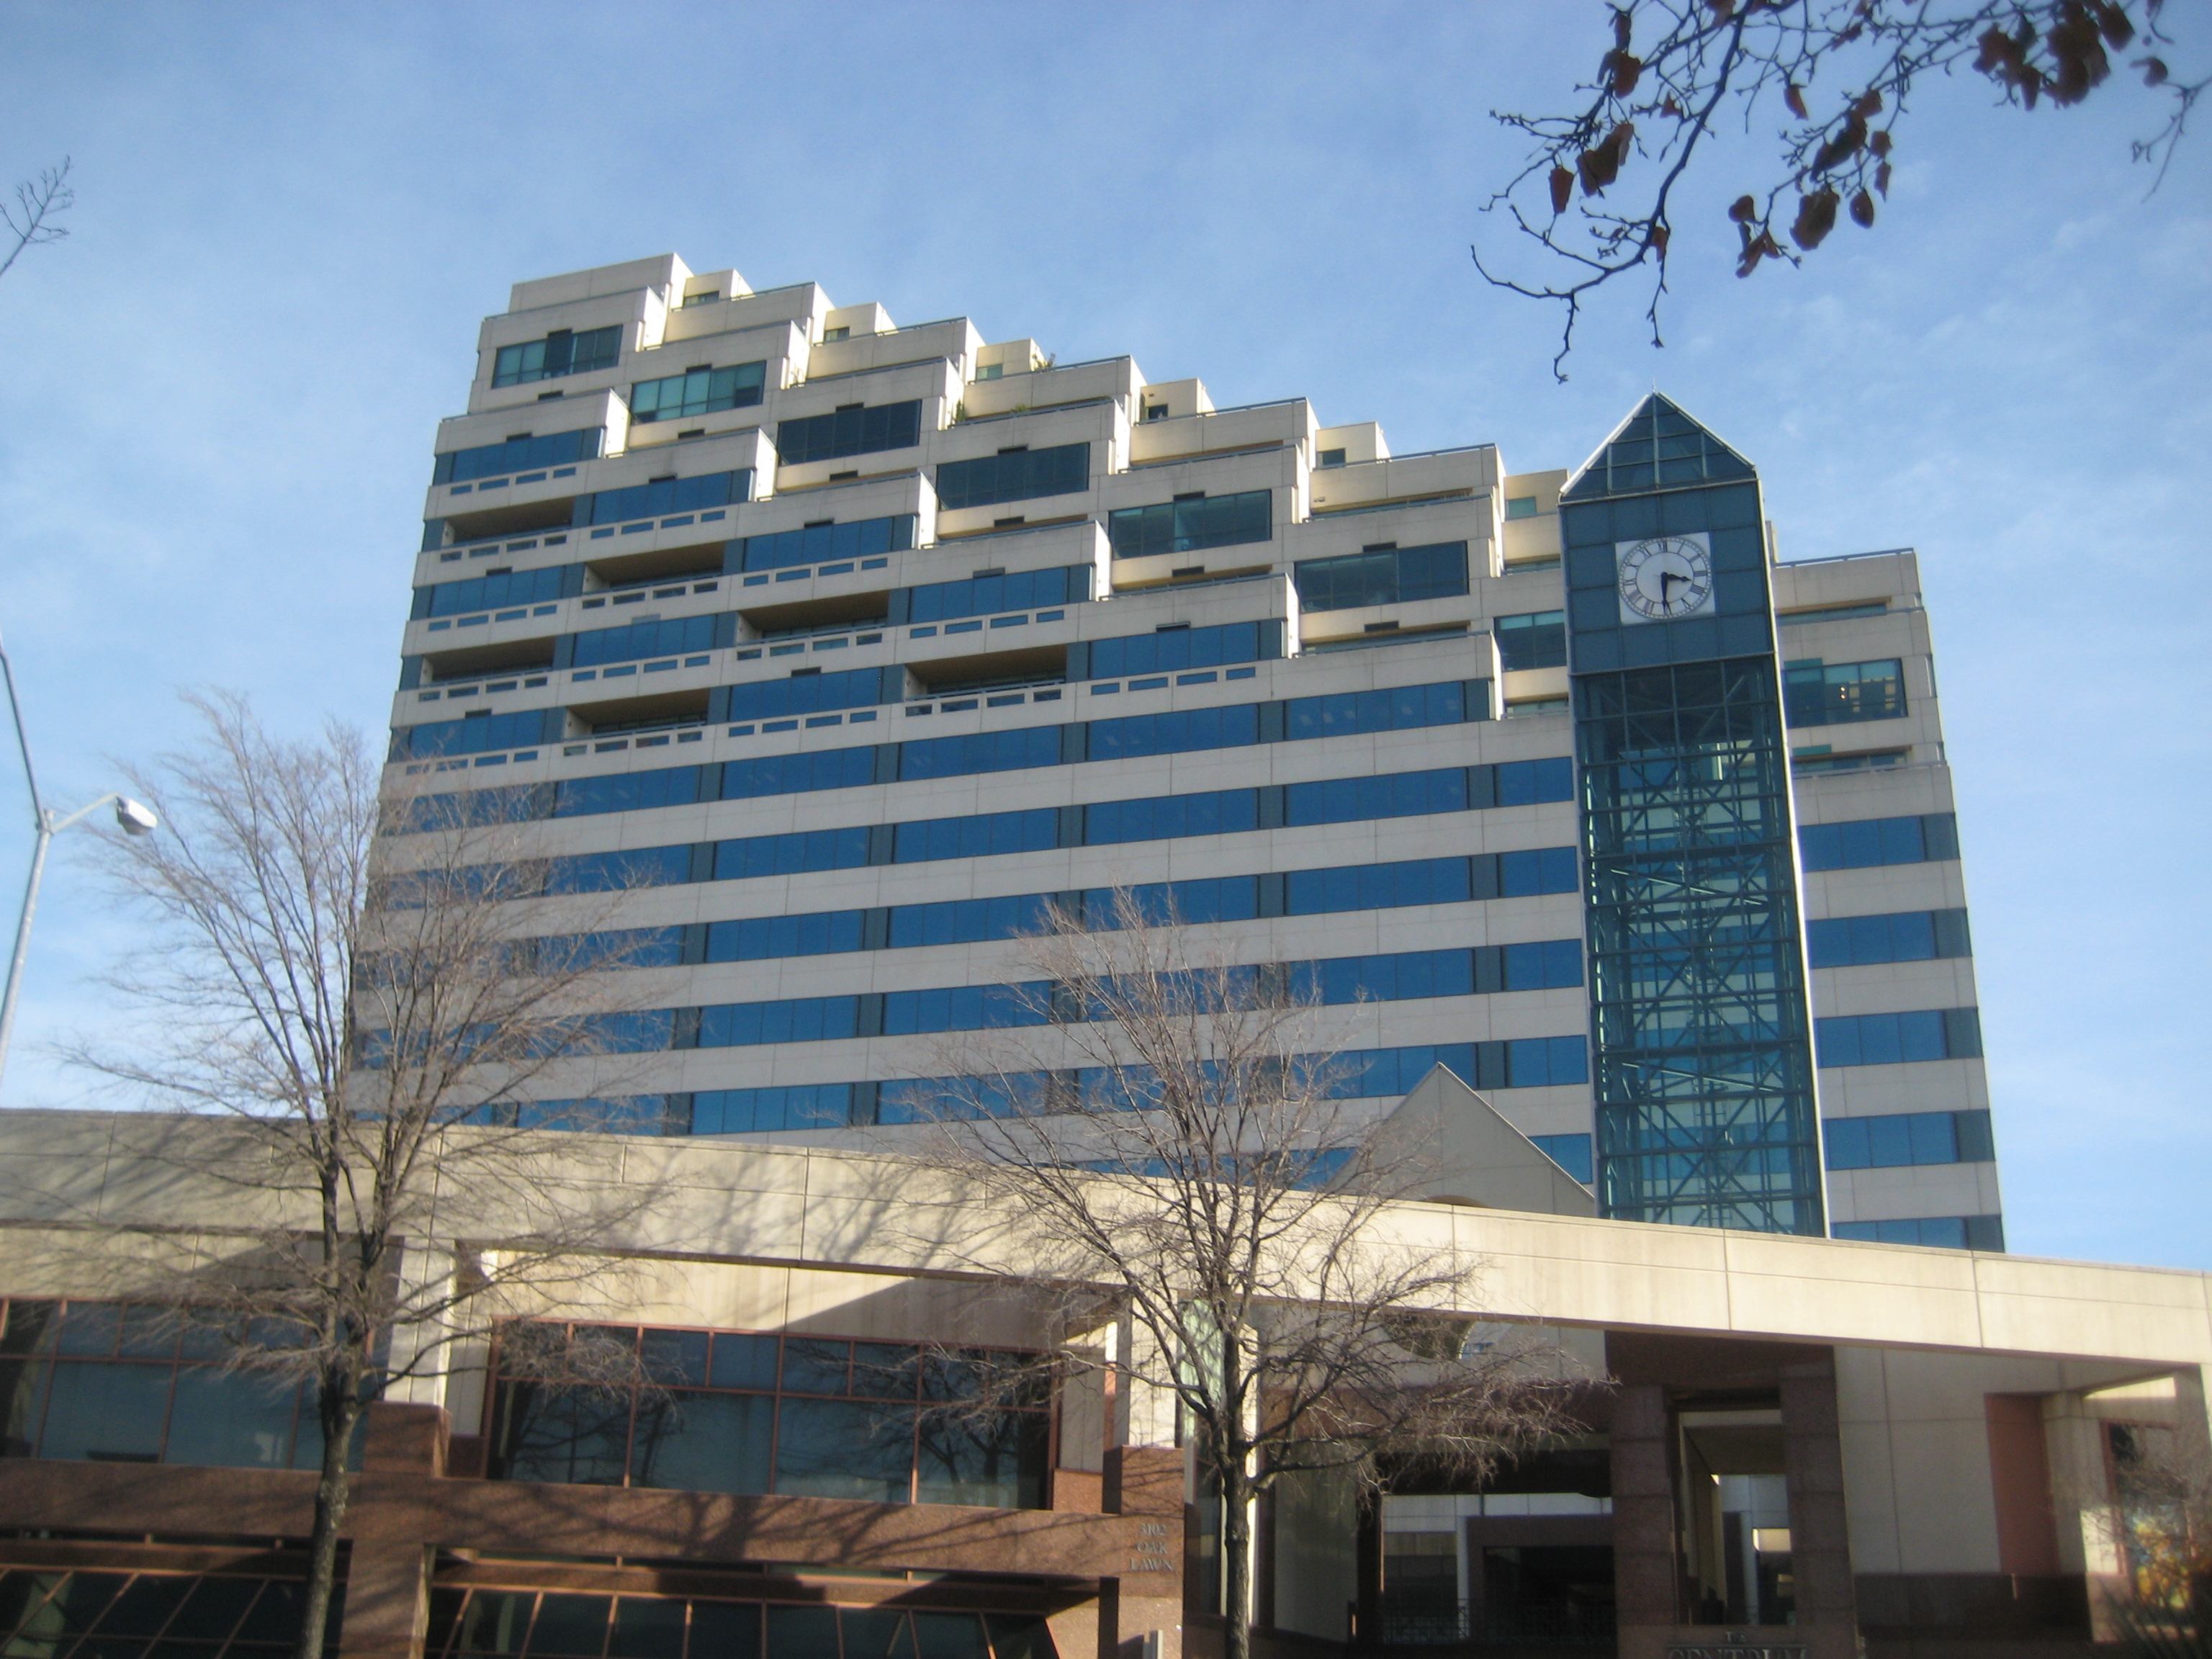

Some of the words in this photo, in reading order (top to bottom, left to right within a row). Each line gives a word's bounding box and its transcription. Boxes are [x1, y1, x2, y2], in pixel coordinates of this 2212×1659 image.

[1139, 1522, 1168, 1537] 3102
[1136, 1540, 1169, 1555] OAK
[1129, 1557, 1176, 1573] LAWN
